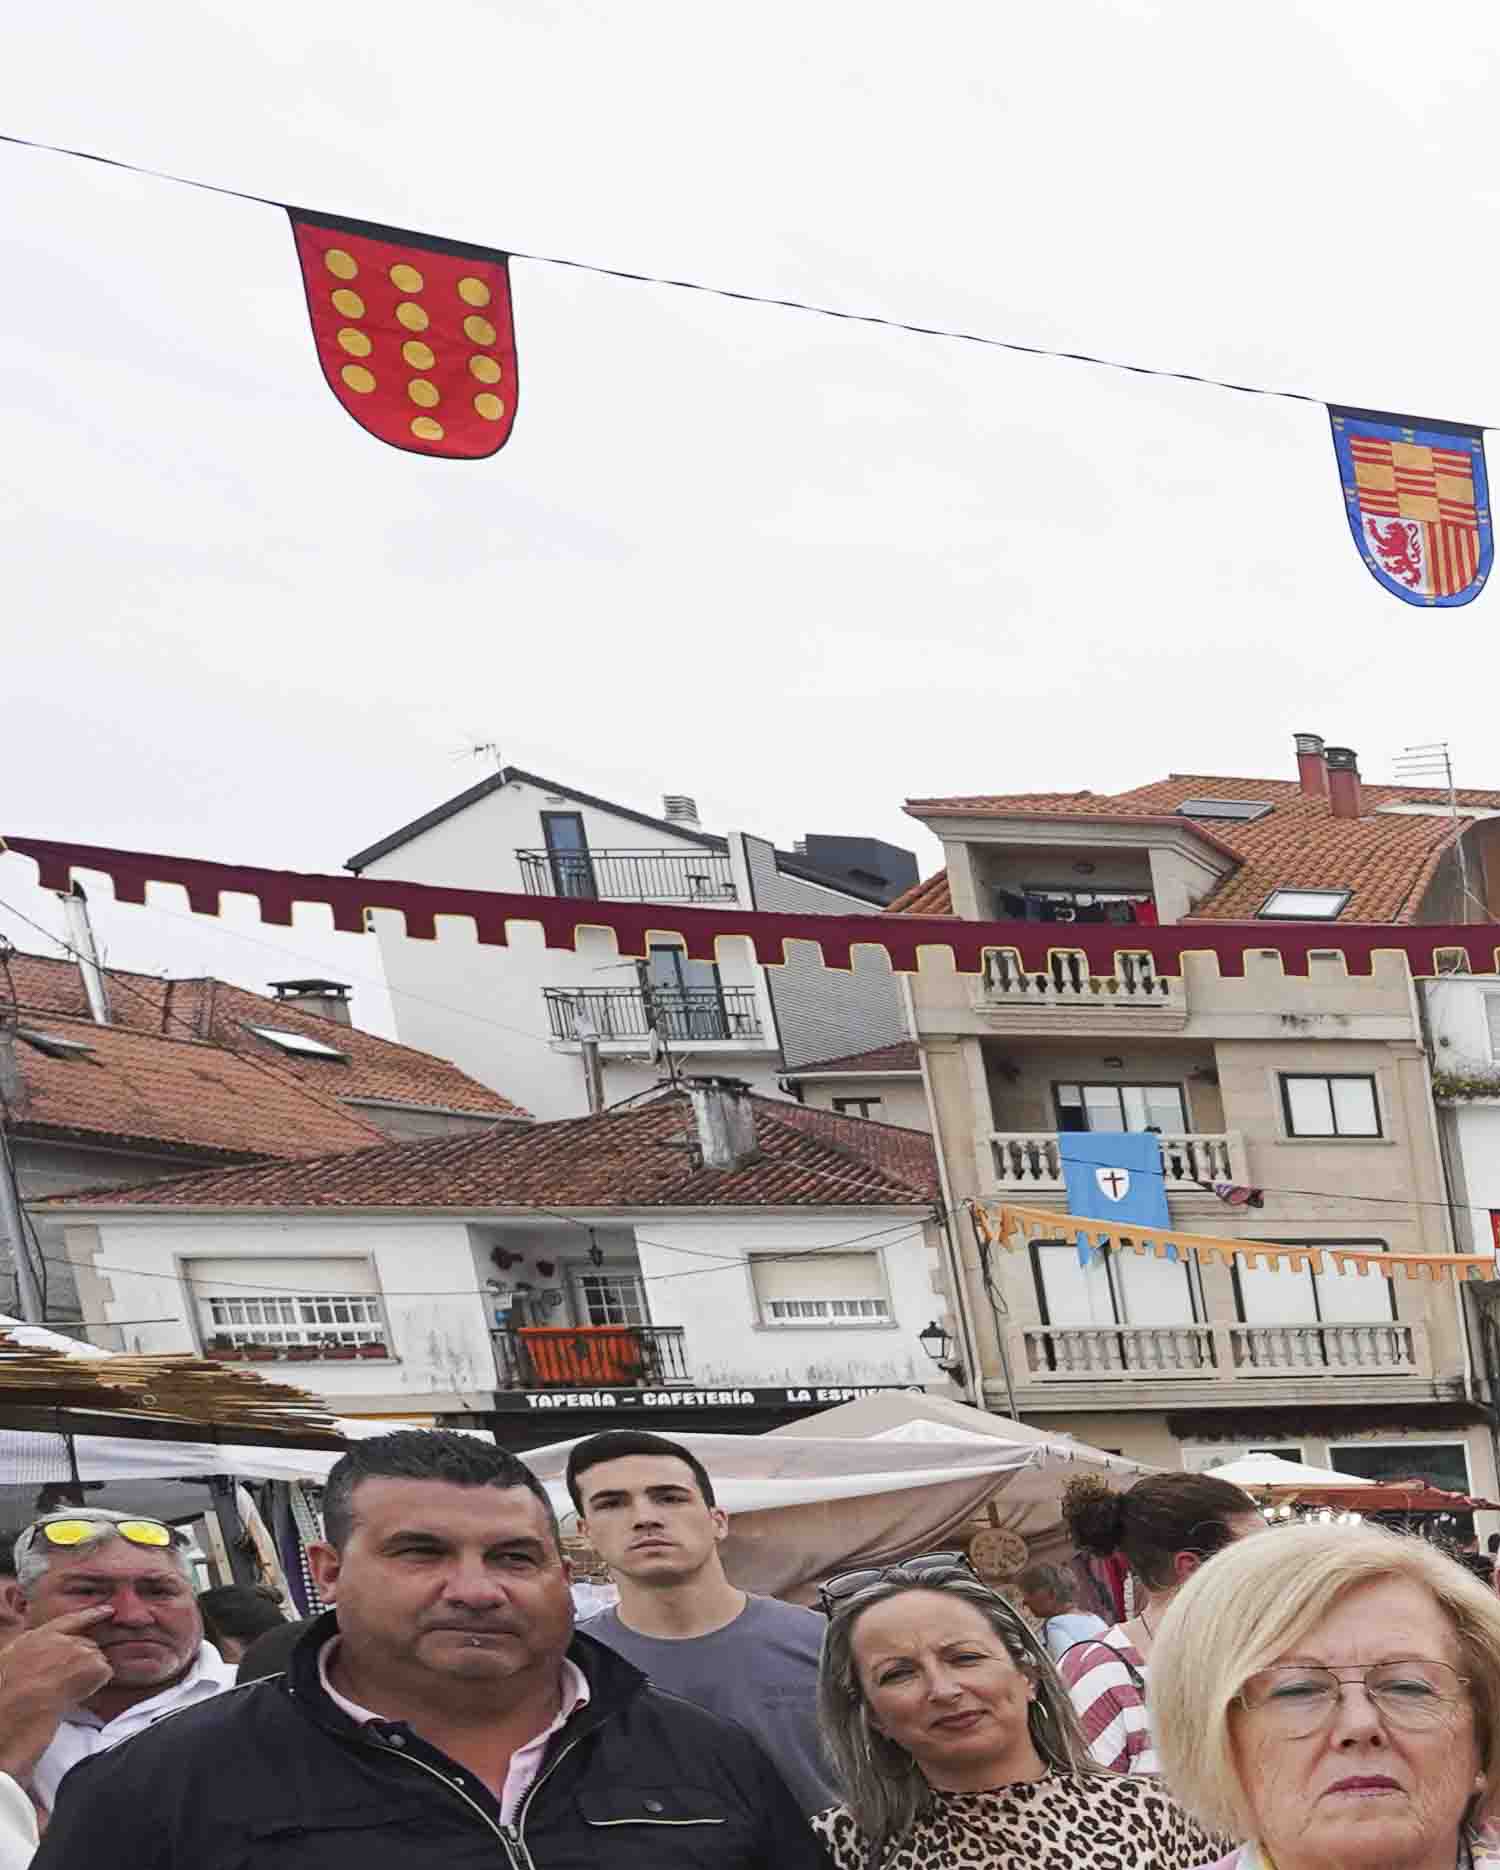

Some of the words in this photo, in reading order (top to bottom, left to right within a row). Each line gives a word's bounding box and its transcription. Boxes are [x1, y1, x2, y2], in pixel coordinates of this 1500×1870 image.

[525, 1390, 617, 1409] TAPERÍA
[642, 1389, 756, 1407] CAFETERÍA
[786, 1389, 812, 1403] LA
[816, 1388, 886, 1402] ESPU
